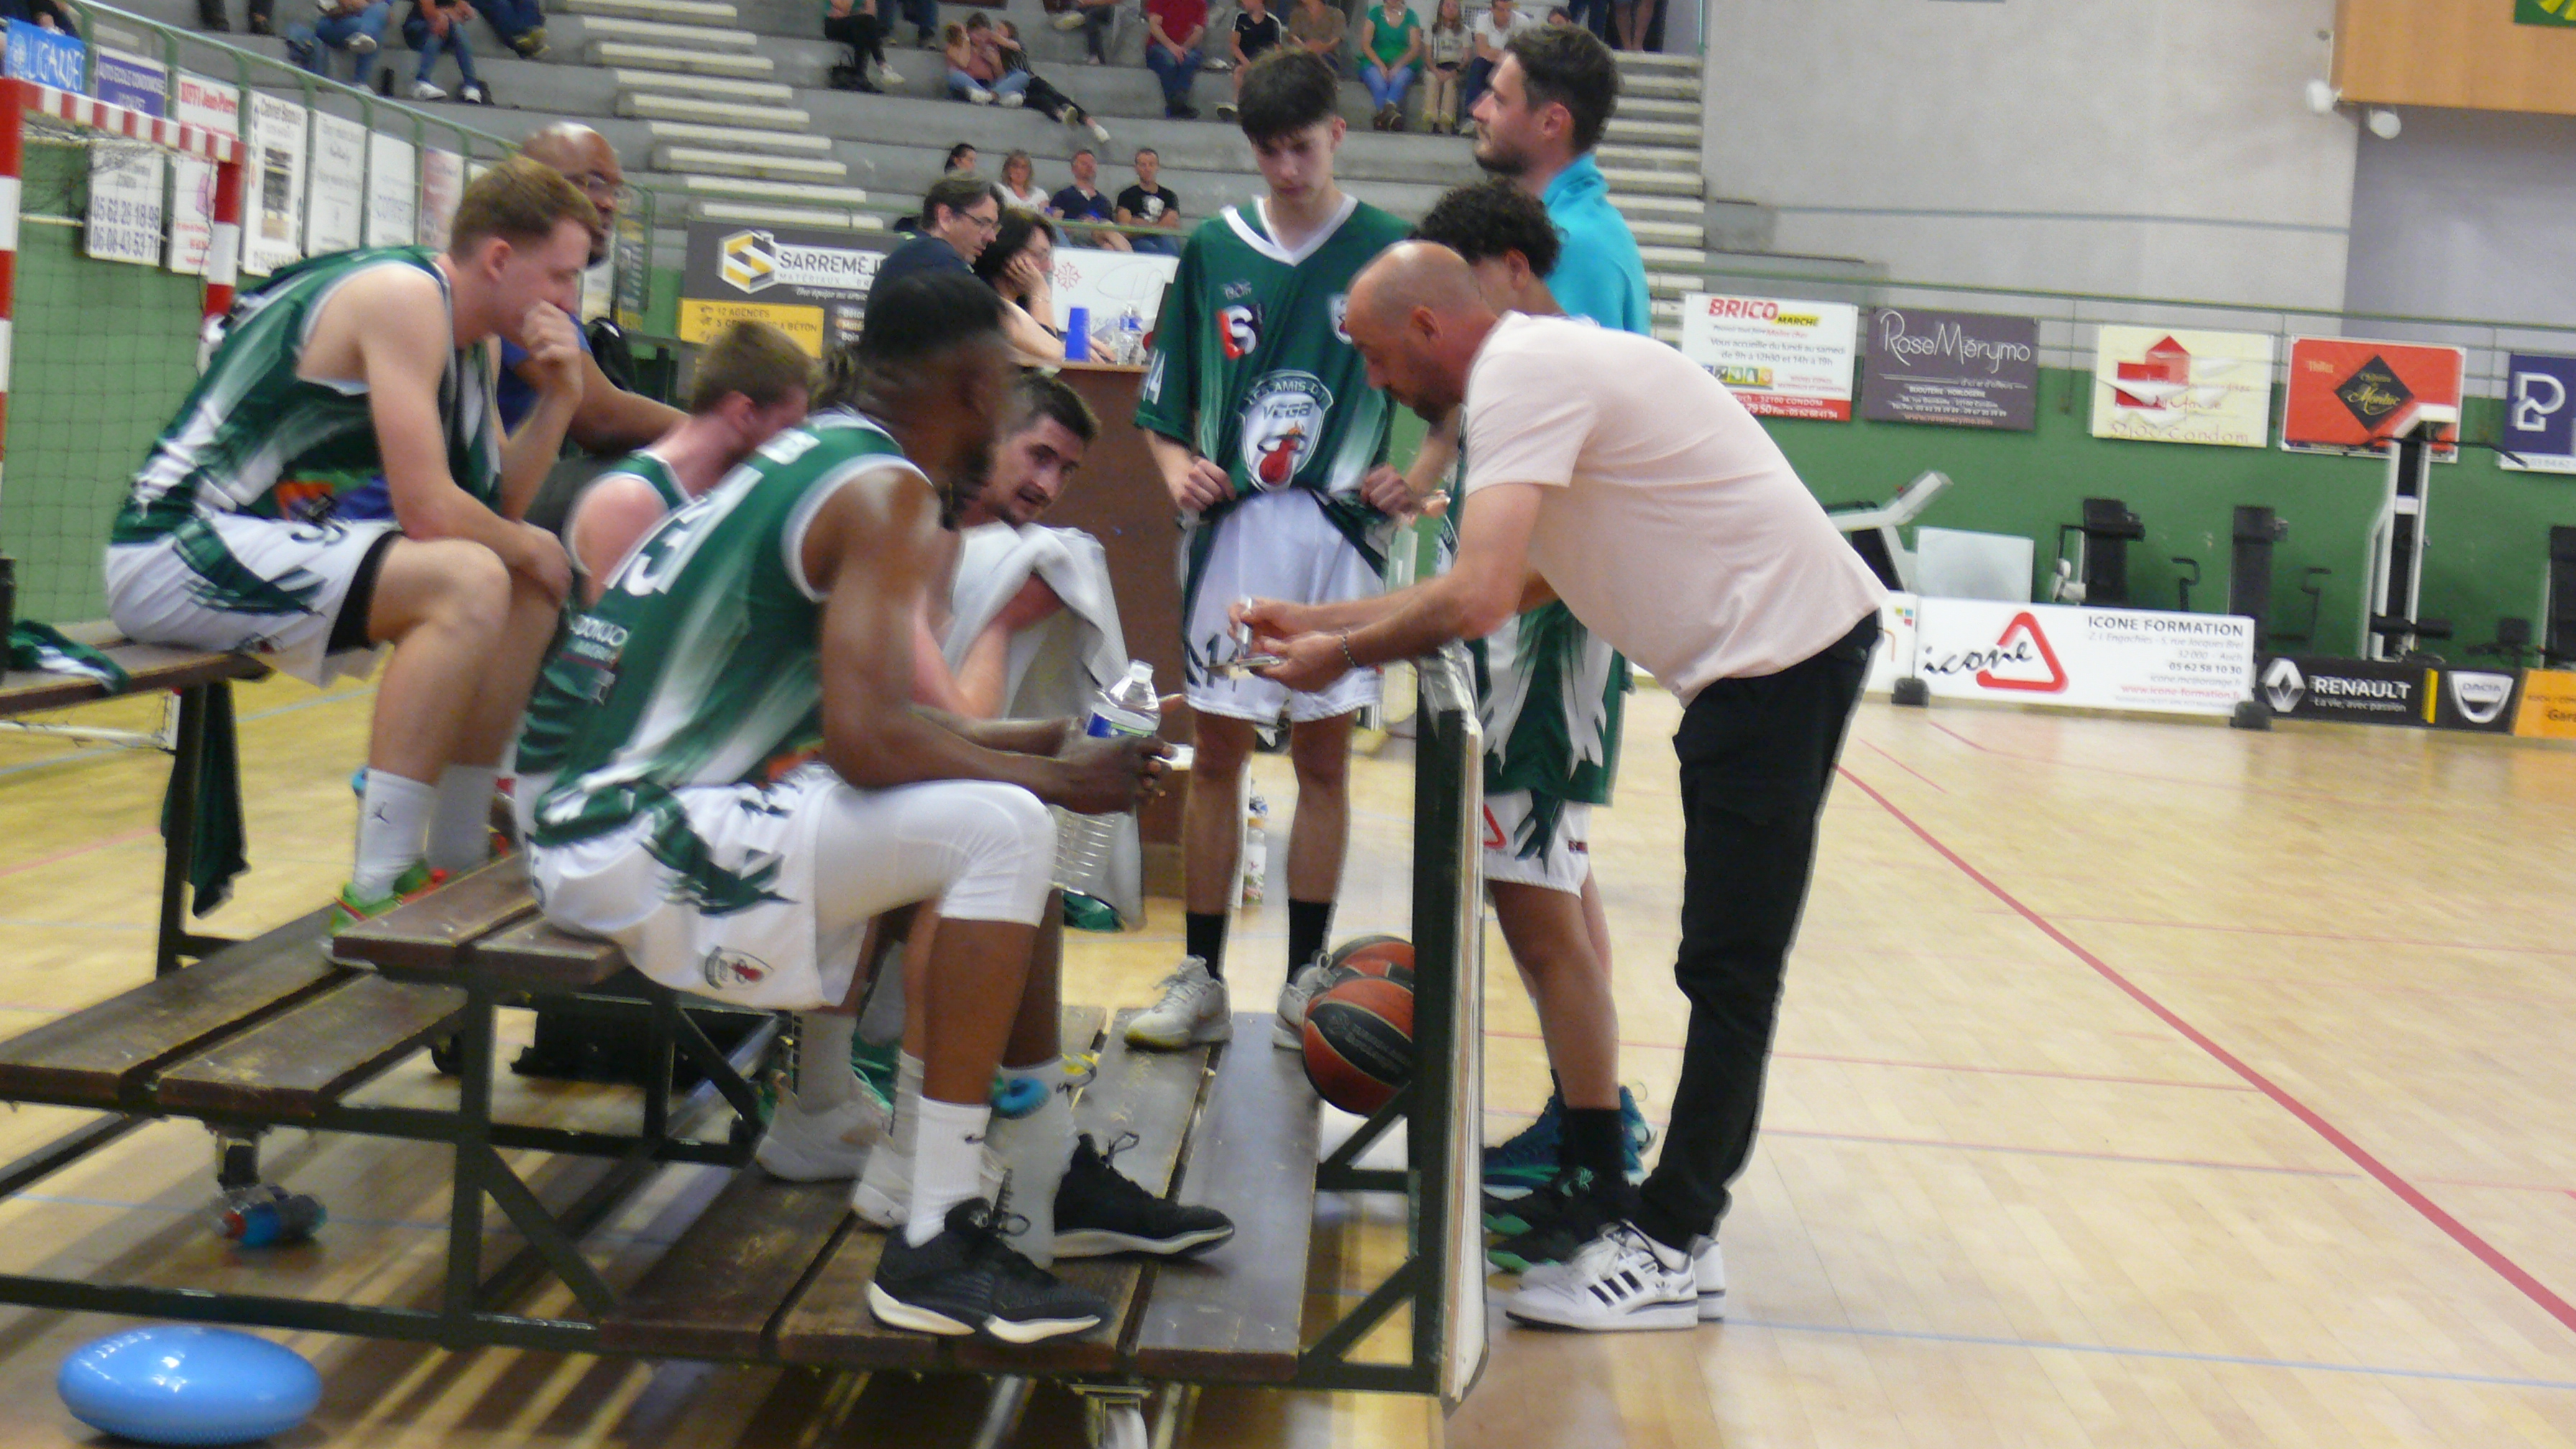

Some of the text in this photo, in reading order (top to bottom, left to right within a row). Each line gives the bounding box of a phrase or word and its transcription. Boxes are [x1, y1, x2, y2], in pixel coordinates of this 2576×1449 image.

[729, 308, 771, 318] AGENCES
[1708, 298, 1780, 321] BRICO
[1711, 338, 1731, 346] Vous
[1732, 339, 1767, 349] accueille
[1769, 341, 1780, 351] du
[1782, 341, 1803, 351] lundi
[1816, 345, 1846, 354] samedi
[1721, 350, 1733, 359] de
[1735, 350, 1747, 359] 9h
[1756, 352, 1780, 363] 12h30
[1782, 354, 1791, 363] et
[1273, 380, 1307, 392] AMIS
[1908, 385, 1944, 395] BIJOUTERIE
[1786, 397, 1823, 407] CONDOM
[2088, 615, 2244, 637] ICONE FORMATION
[2187, 638, 2225, 650] Jacques
[2226, 640, 2244, 650] Brel
[1923, 641, 2033, 674] icone
[2179, 650, 2189, 658] 32
[2220, 652, 2242, 661] Auch
[2168, 662, 2242, 675] 05 62 58 10 30
[2121, 684, 2241, 700] www.icone-formation.fr
[2312, 678, 2411, 699] RENAULT
[2462, 683, 2501, 692] DACIA
[2314, 697, 2327, 707] La
[2346, 700, 2368, 709] avec
[2369, 701, 2407, 713] passion
